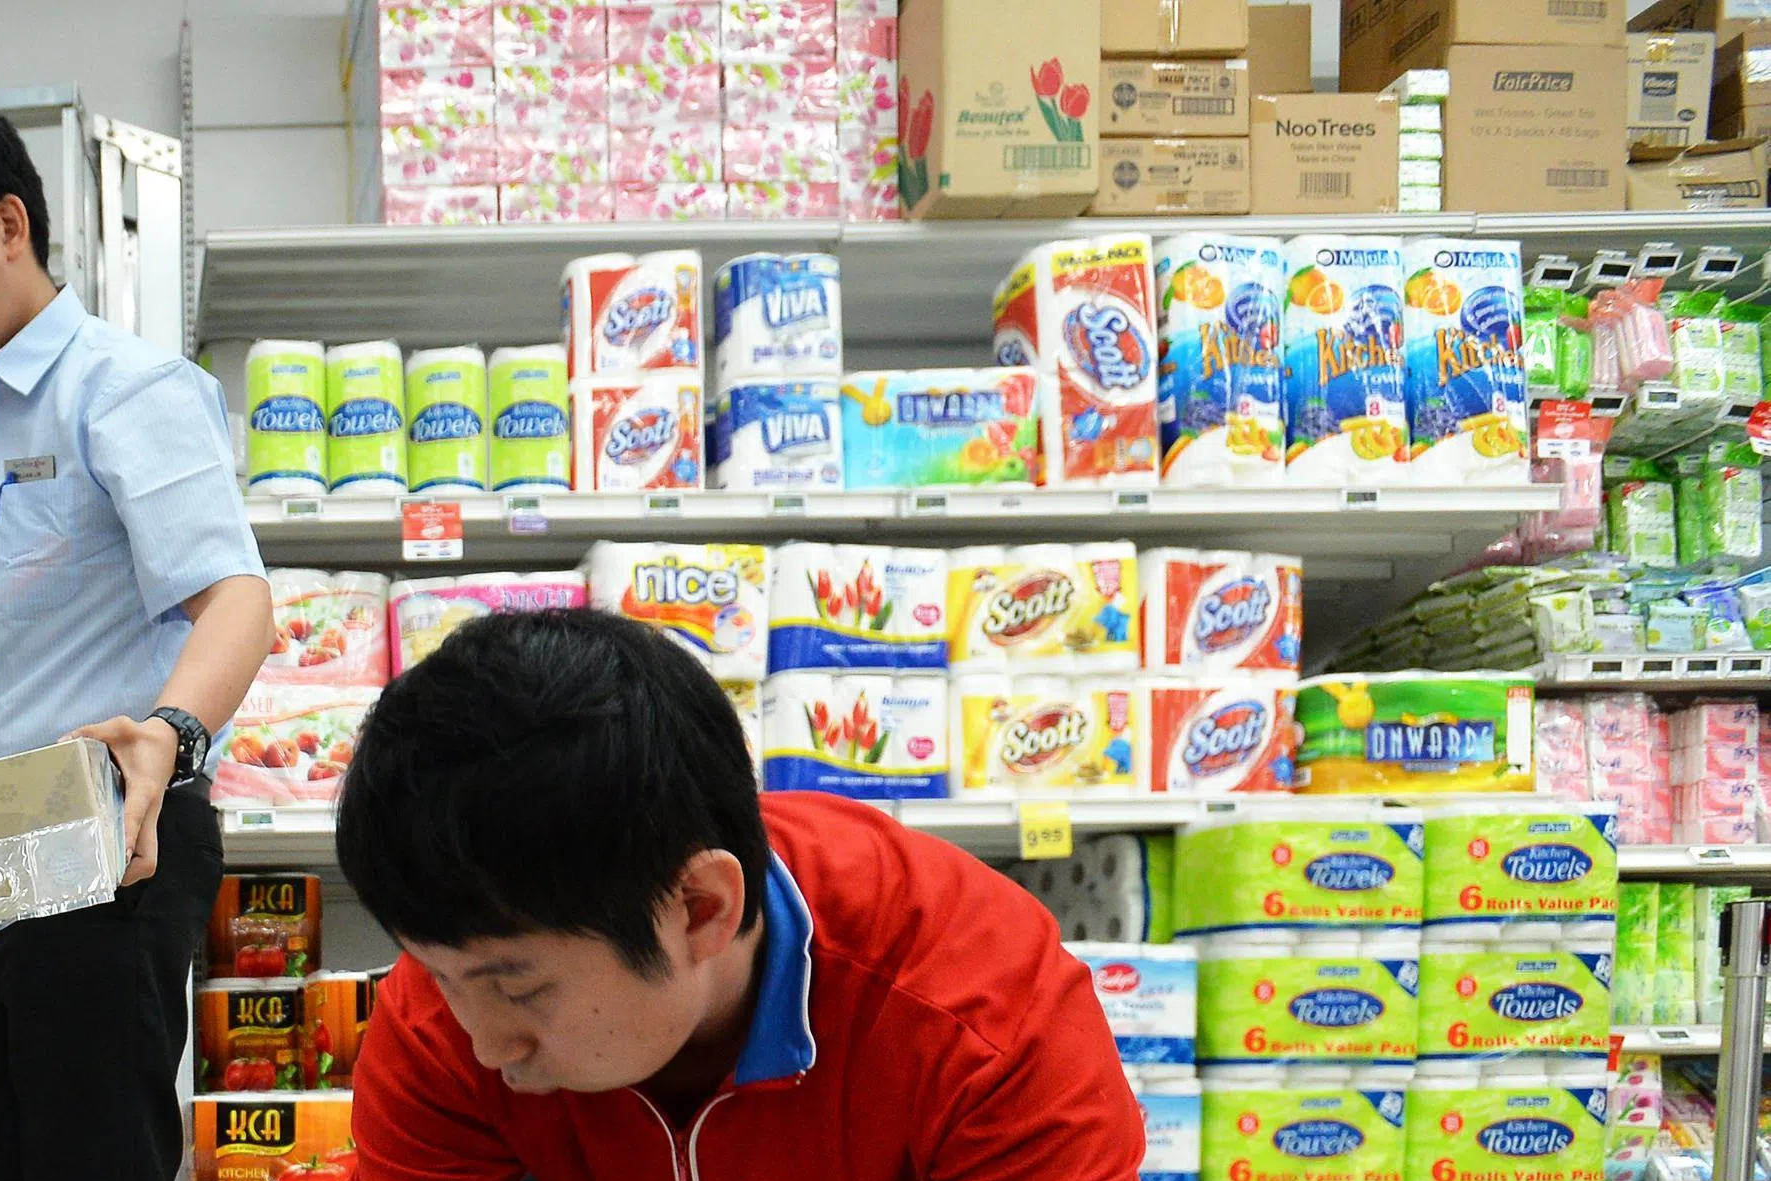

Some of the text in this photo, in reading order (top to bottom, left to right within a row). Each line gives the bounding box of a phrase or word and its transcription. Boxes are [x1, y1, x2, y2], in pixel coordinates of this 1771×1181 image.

[1495, 73, 1571, 90] FairPrice
[1276, 119, 1375, 137] NooTrees
[604, 292, 674, 339] Scott
[765, 286, 825, 327] VIVA
[1077, 303, 1142, 391] Scott
[607, 412, 677, 460] Scott
[765, 413, 825, 452] VIVA
[634, 555, 738, 604] nice
[984, 575, 1075, 635] Scott
[1194, 583, 1271, 640] Scott
[1002, 708, 1087, 763] Scott
[1185, 710, 1266, 765] Scott
[1370, 726, 1492, 760] ONWARDS
[1529, 846, 1570, 859] Kitchen
[1309, 861, 1389, 891] Towels
[1506, 857, 1588, 880] Towels
[249, 882, 294, 912] KCA
[1459, 885, 1483, 911] 6
[1486, 898, 1531, 911] Rolls
[1538, 897, 1585, 910] Value
[238, 996, 283, 1026] KCA
[1293, 999, 1380, 1027] Towels
[1495, 993, 1577, 1019] Towels
[225, 1108, 281, 1145] KCA
[1482, 1128, 1570, 1155] Towels
[1274, 1130, 1360, 1155] Towels
[218, 1167, 270, 1180] KITCHEN
[1515, 1169, 1564, 1181] Value
